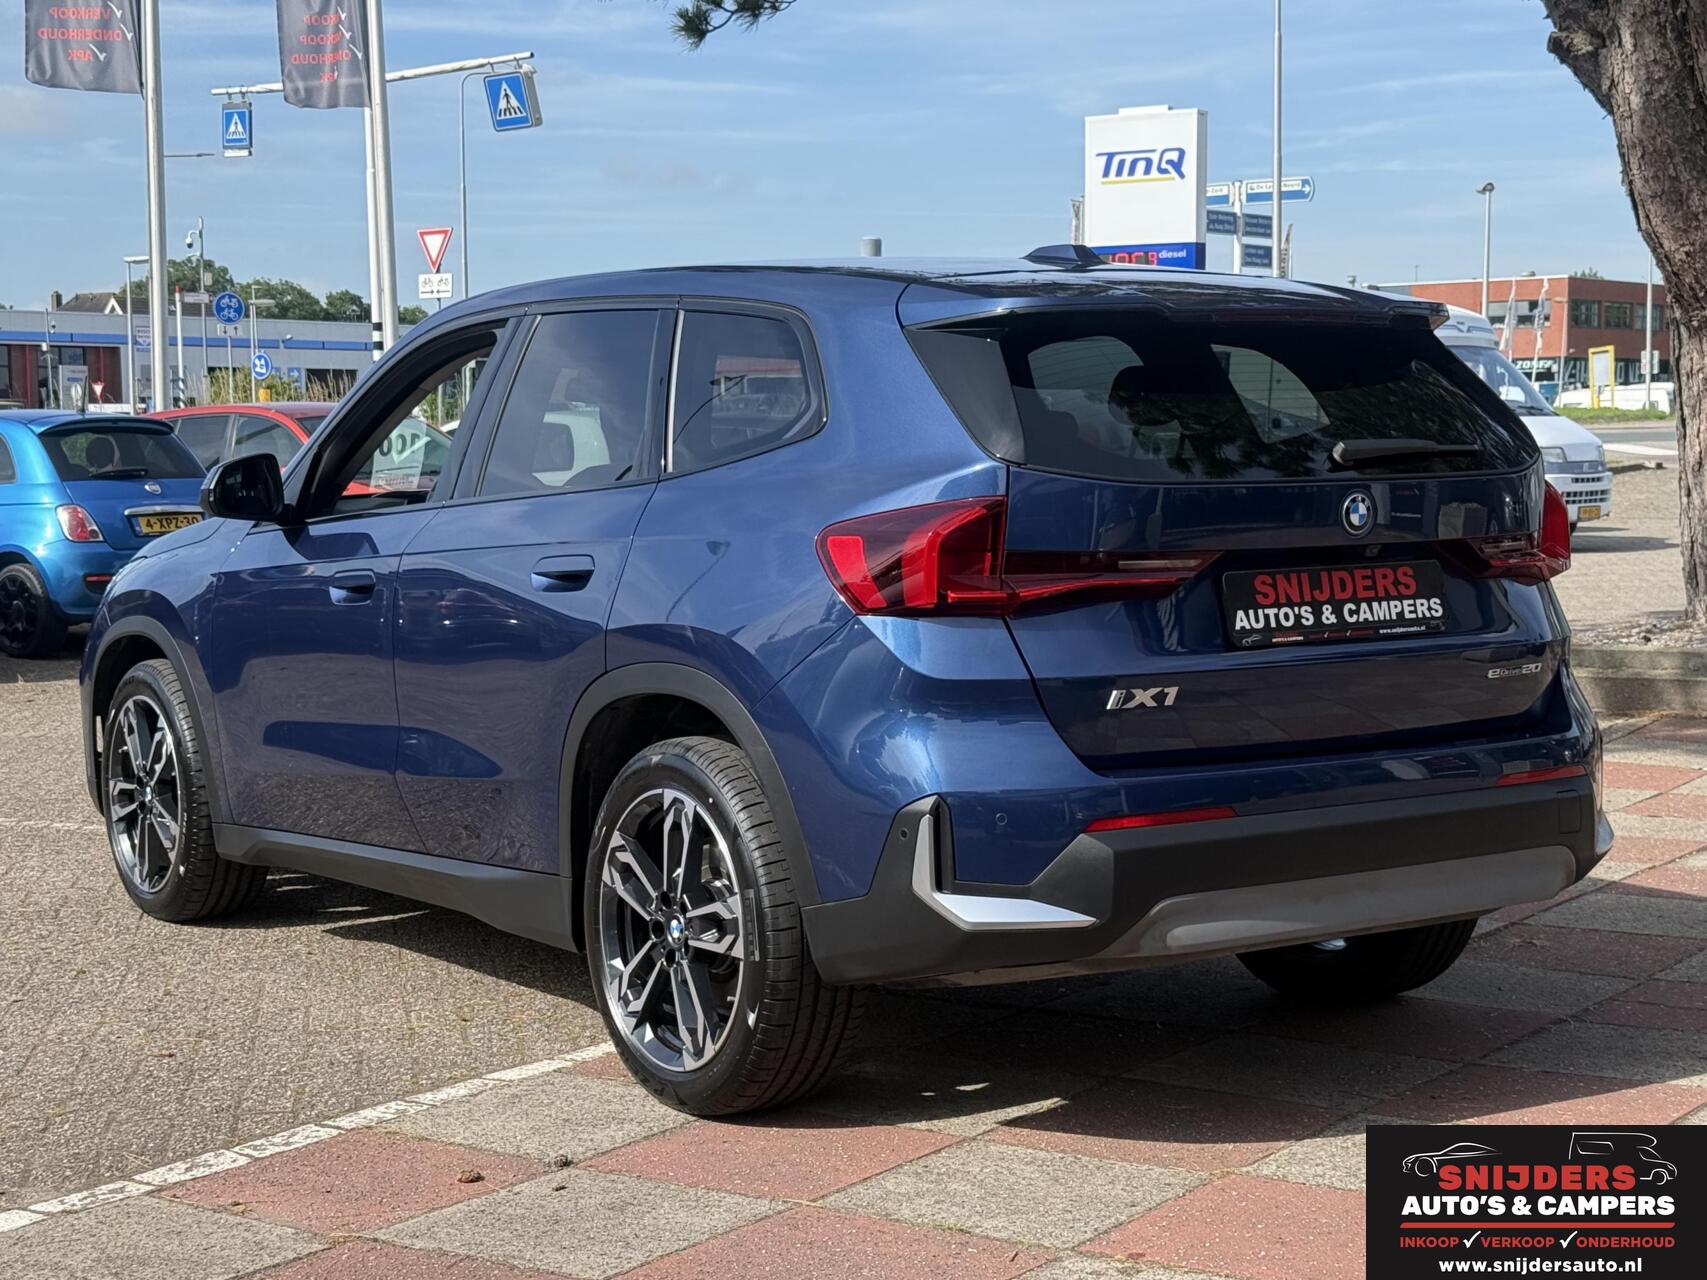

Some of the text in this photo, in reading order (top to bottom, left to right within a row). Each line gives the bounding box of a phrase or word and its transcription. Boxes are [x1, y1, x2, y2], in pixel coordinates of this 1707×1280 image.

[1158, 248, 1187, 259] diesel
[145, 514, 200, 530] 4-XPZ-30
[1253, 566, 1417, 605] SNIJDERS
[1235, 597, 1443, 631] AUTO'S & CAMPERS
[1106, 686, 1180, 710] iX1
